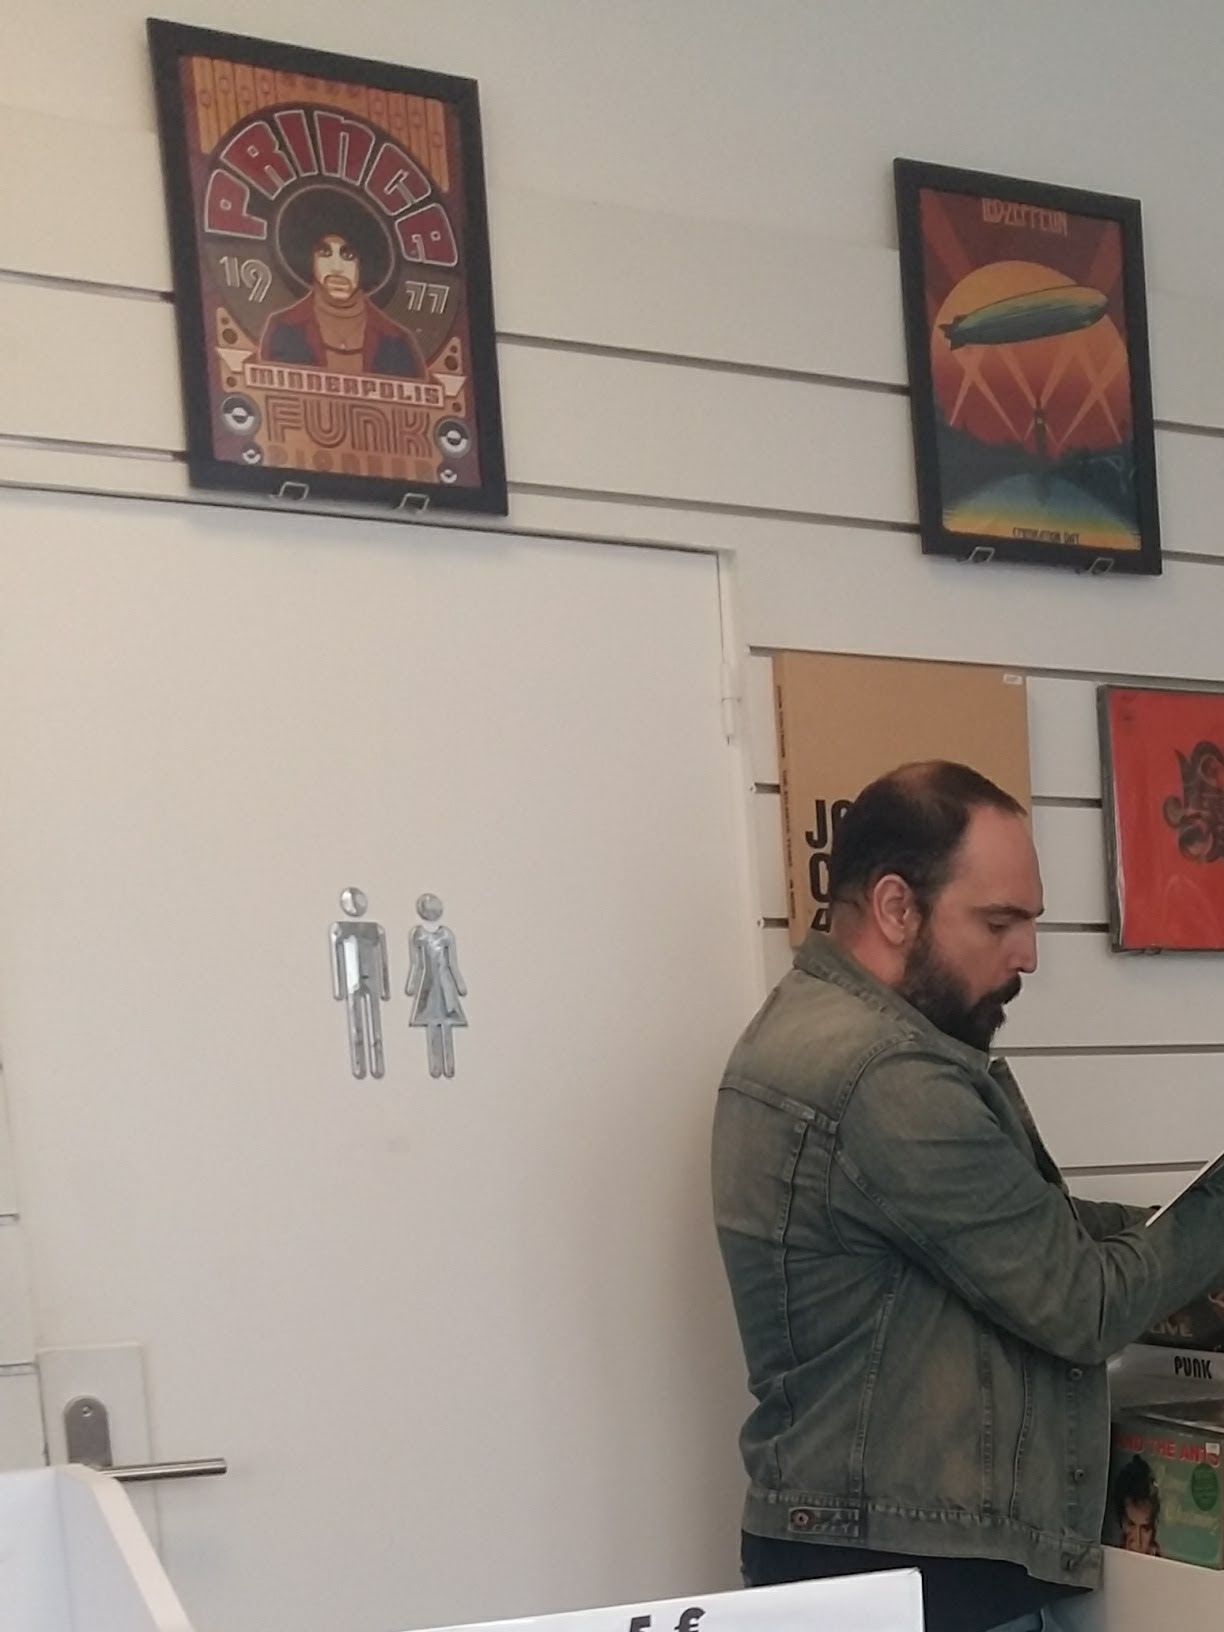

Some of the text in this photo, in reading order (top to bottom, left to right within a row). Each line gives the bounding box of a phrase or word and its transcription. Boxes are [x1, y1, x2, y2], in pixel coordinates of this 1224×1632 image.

[205, 109, 458, 267] PRINCE
[250, 367, 440, 404] MINNEAPOLIS
[265, 395, 433, 458] FUNK
[1174, 1355, 1213, 1379] PUNK
